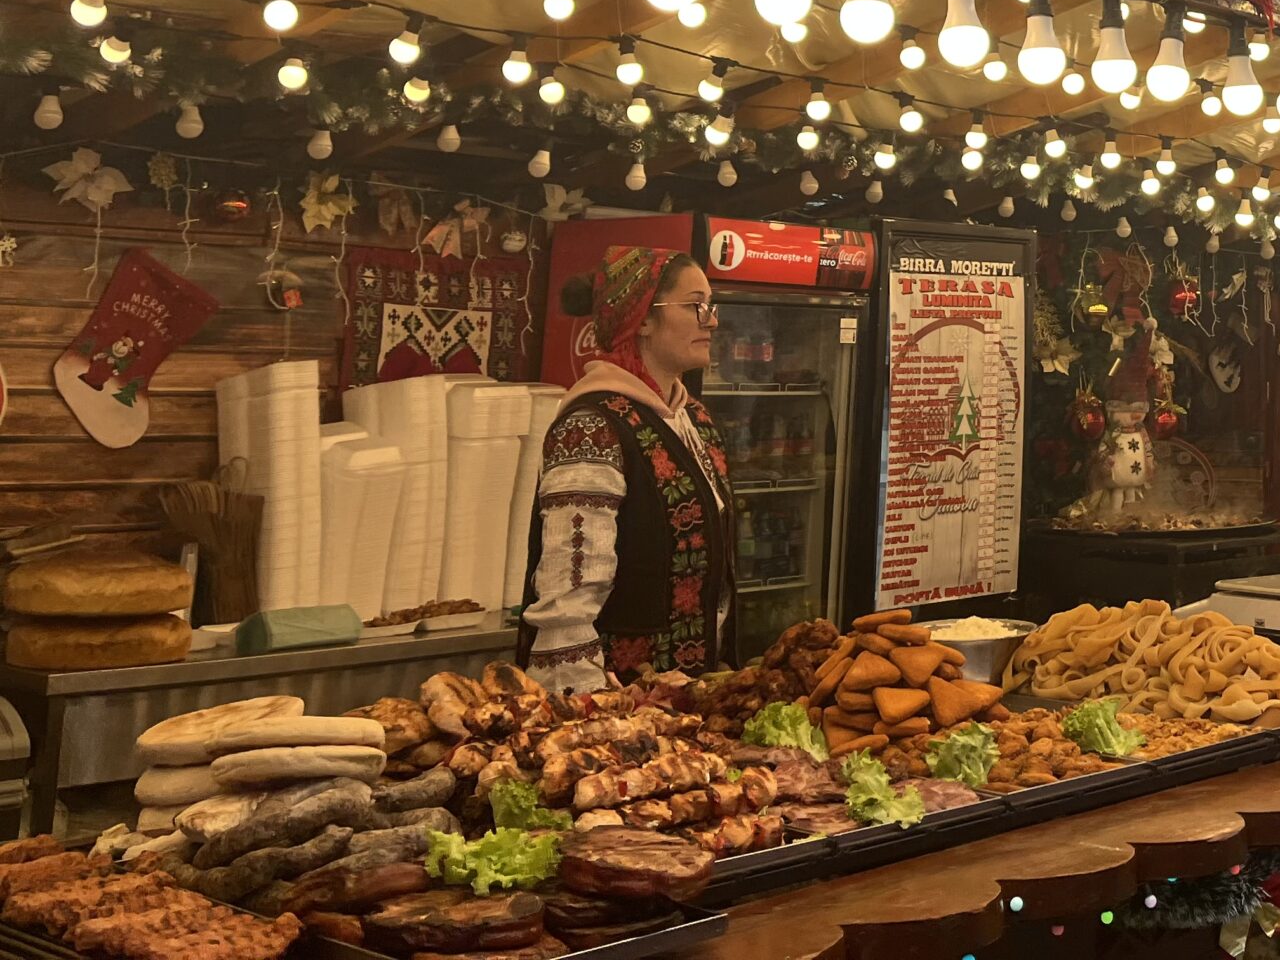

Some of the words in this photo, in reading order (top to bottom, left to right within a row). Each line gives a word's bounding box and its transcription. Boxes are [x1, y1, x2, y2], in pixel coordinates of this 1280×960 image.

[819, 258, 836, 267] zero
[899, 257, 945, 273] BIRRA
[951, 260, 1014, 276] MORETTI
[898, 277, 1014, 298] TERASA
[130, 293, 172, 319] MERRY
[113, 301, 172, 341] CHRISTMAS
[894, 586, 942, 606] POFTĂ
[944, 581, 985, 598] BUNĂ
